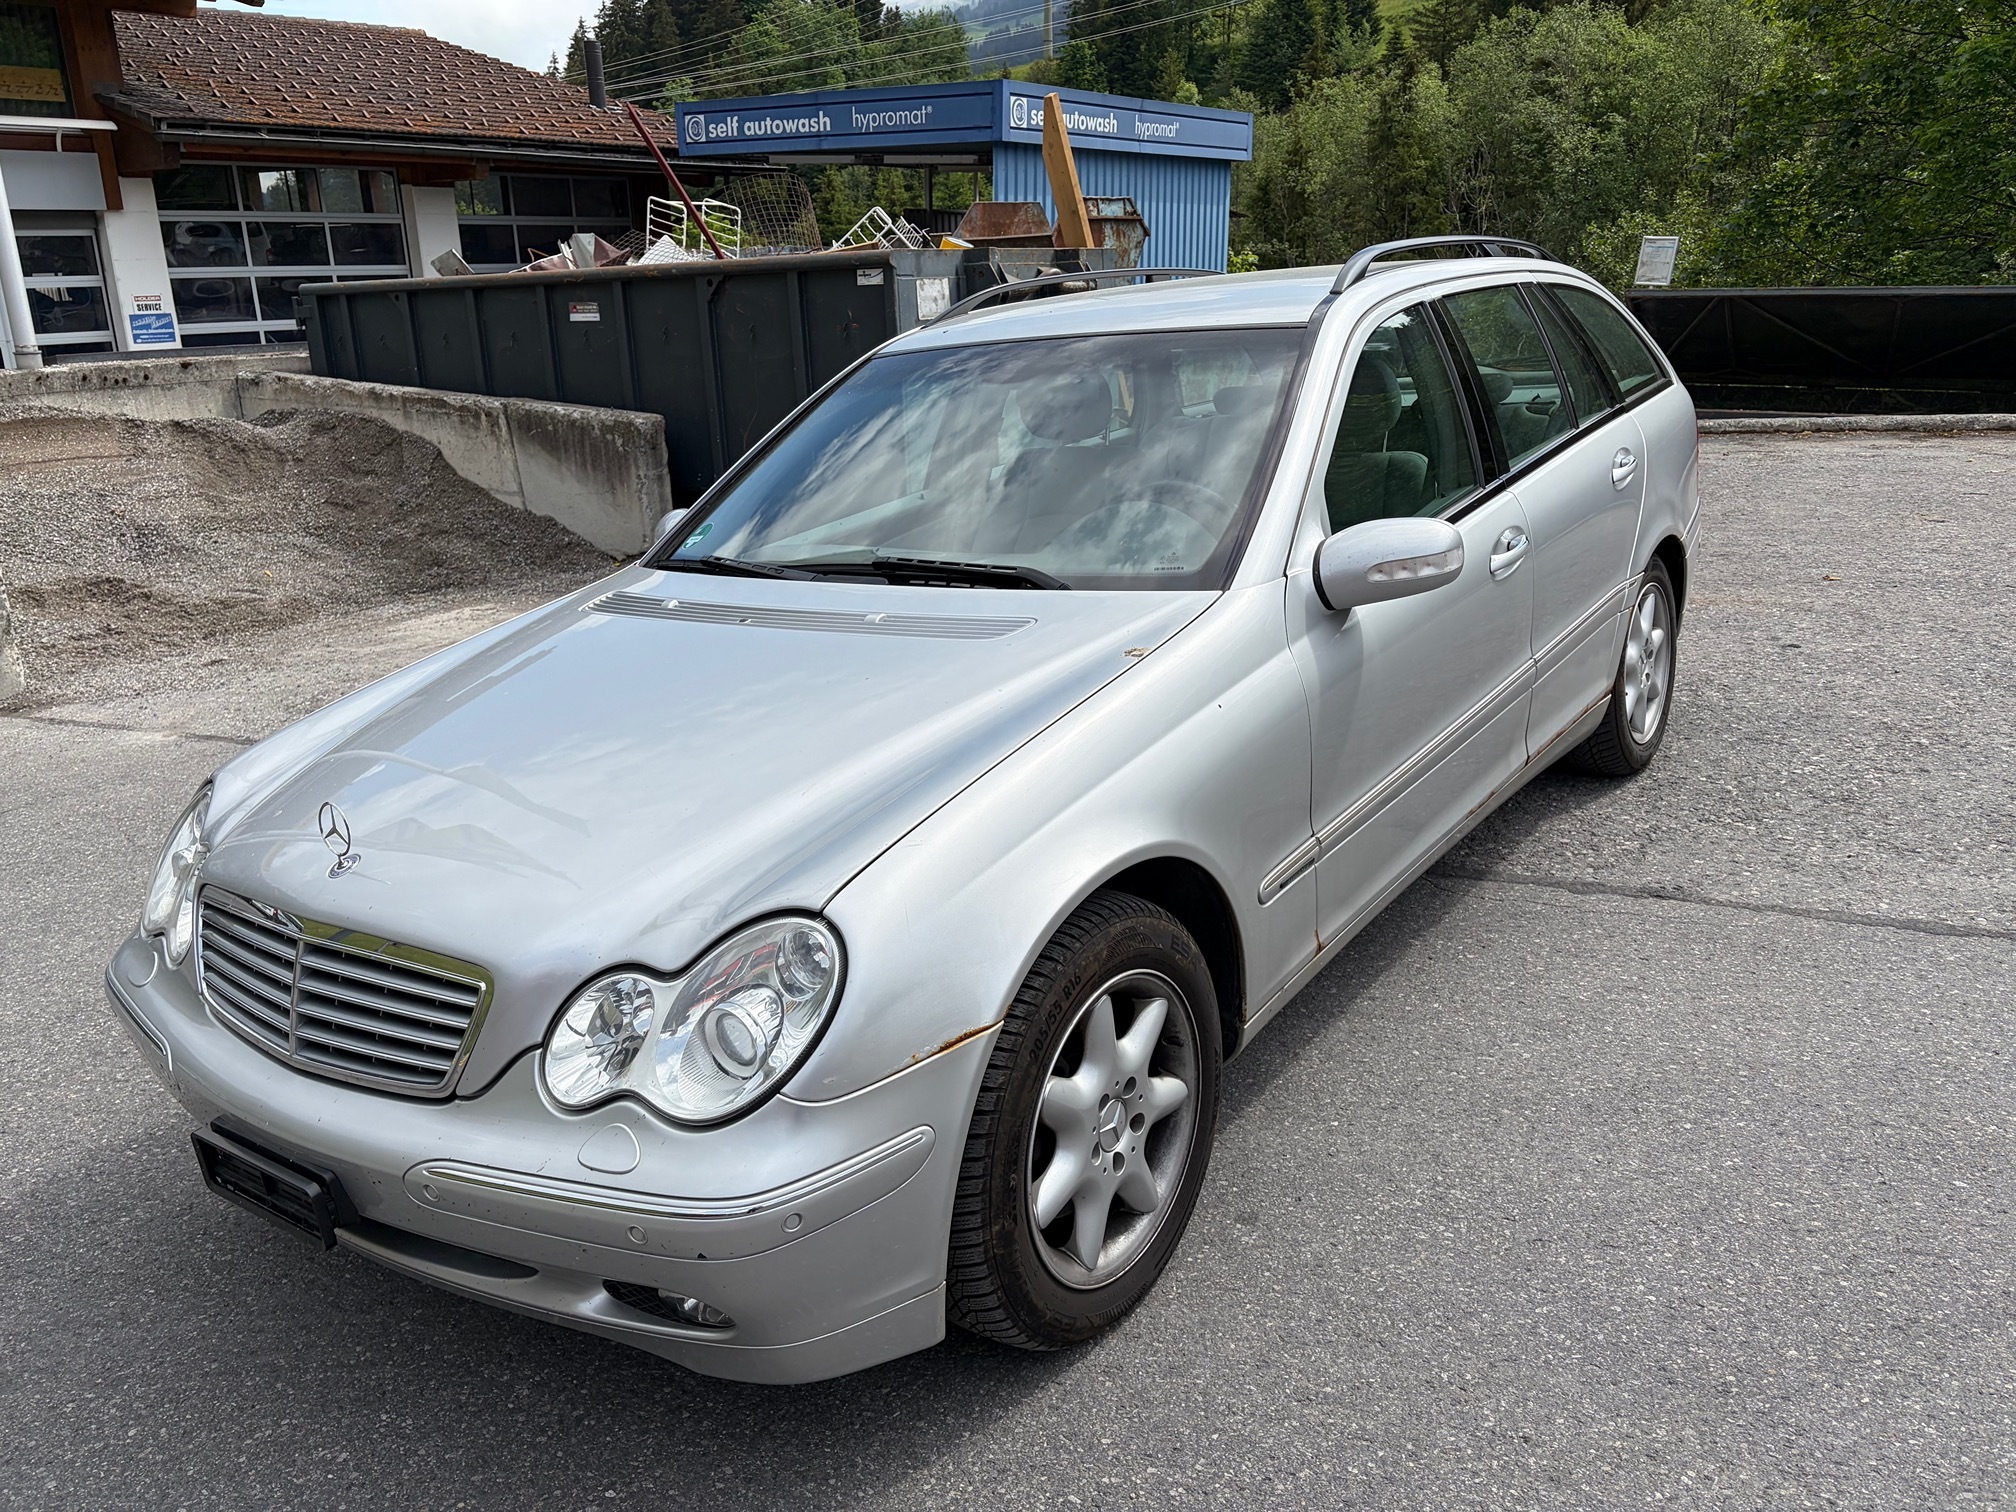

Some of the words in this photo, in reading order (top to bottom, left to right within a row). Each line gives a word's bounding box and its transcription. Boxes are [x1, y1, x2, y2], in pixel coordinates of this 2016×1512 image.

[708, 115, 739, 138] self
[744, 110, 831, 136] autowash
[136, 303, 162, 311] SERVICE
[1029, 1000, 1063, 1063] 205/55
[1062, 971, 1082, 1001] R16
